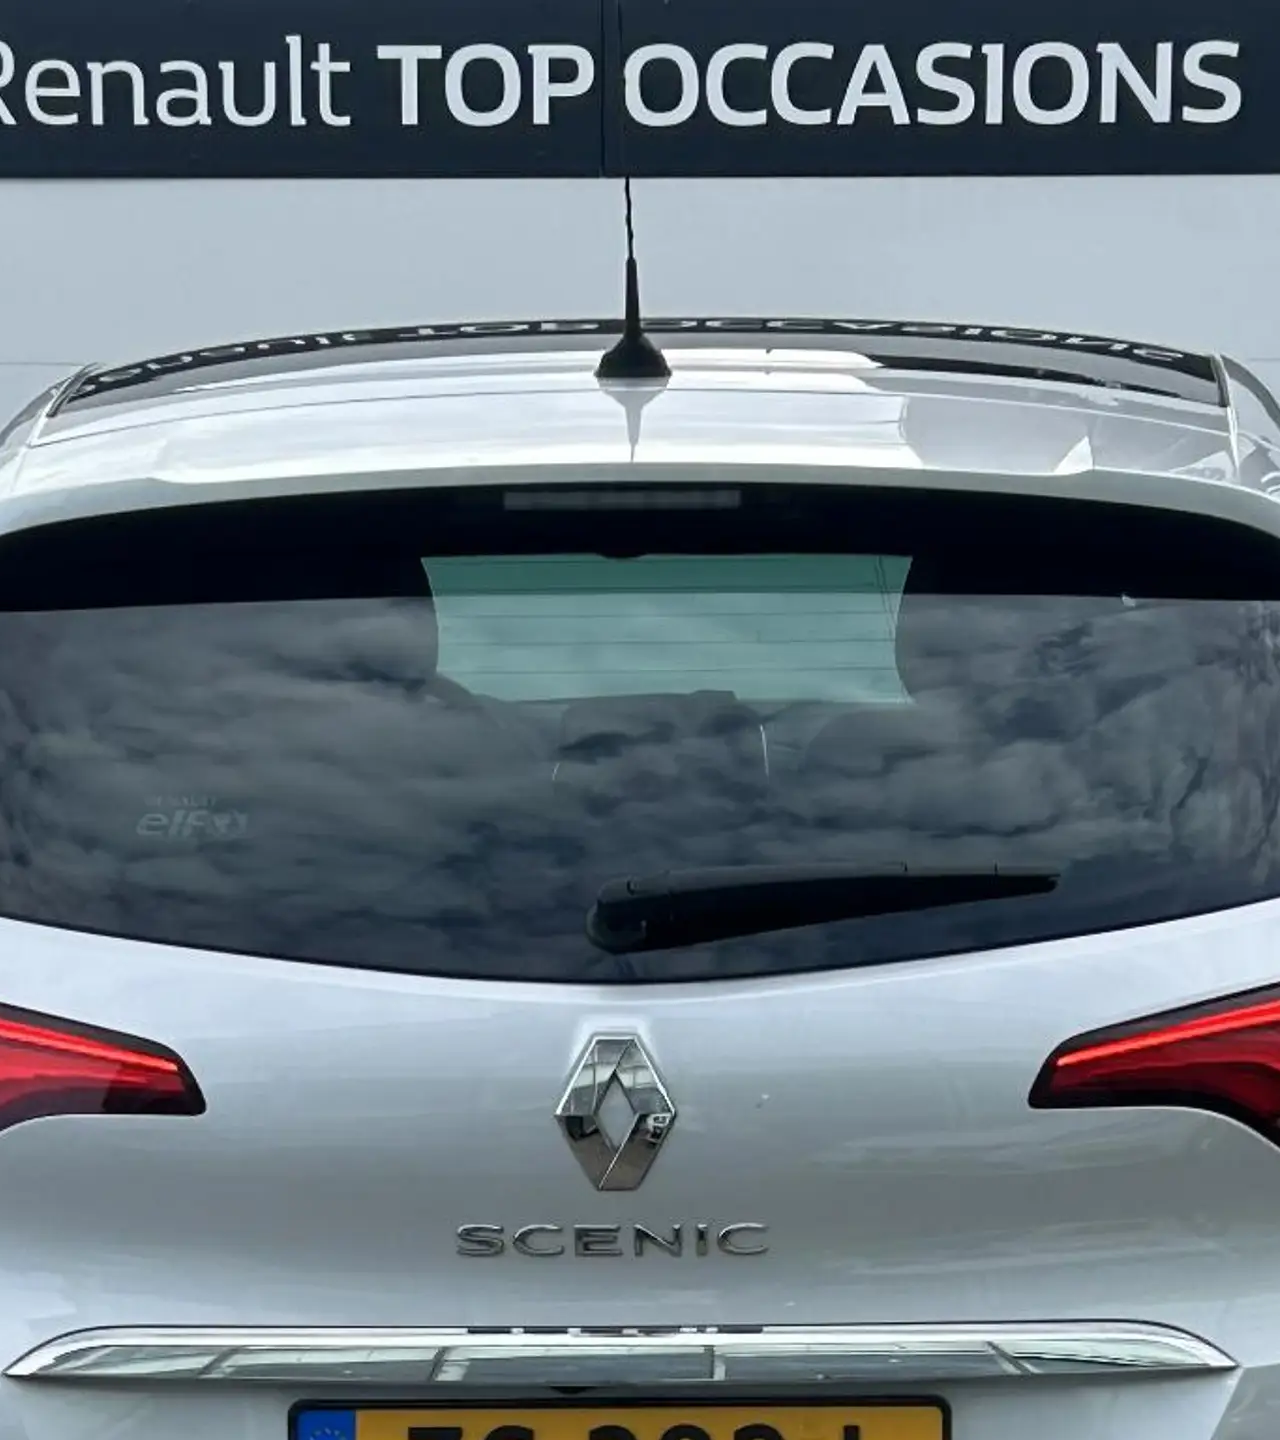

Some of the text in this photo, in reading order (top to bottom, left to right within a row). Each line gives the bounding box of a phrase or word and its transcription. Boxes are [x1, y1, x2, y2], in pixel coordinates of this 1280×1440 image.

[376, 43, 595, 127] TOP
[623, 40, 1242, 127] OCCASIONS
[457, 1223, 769, 1257] SCENIC
